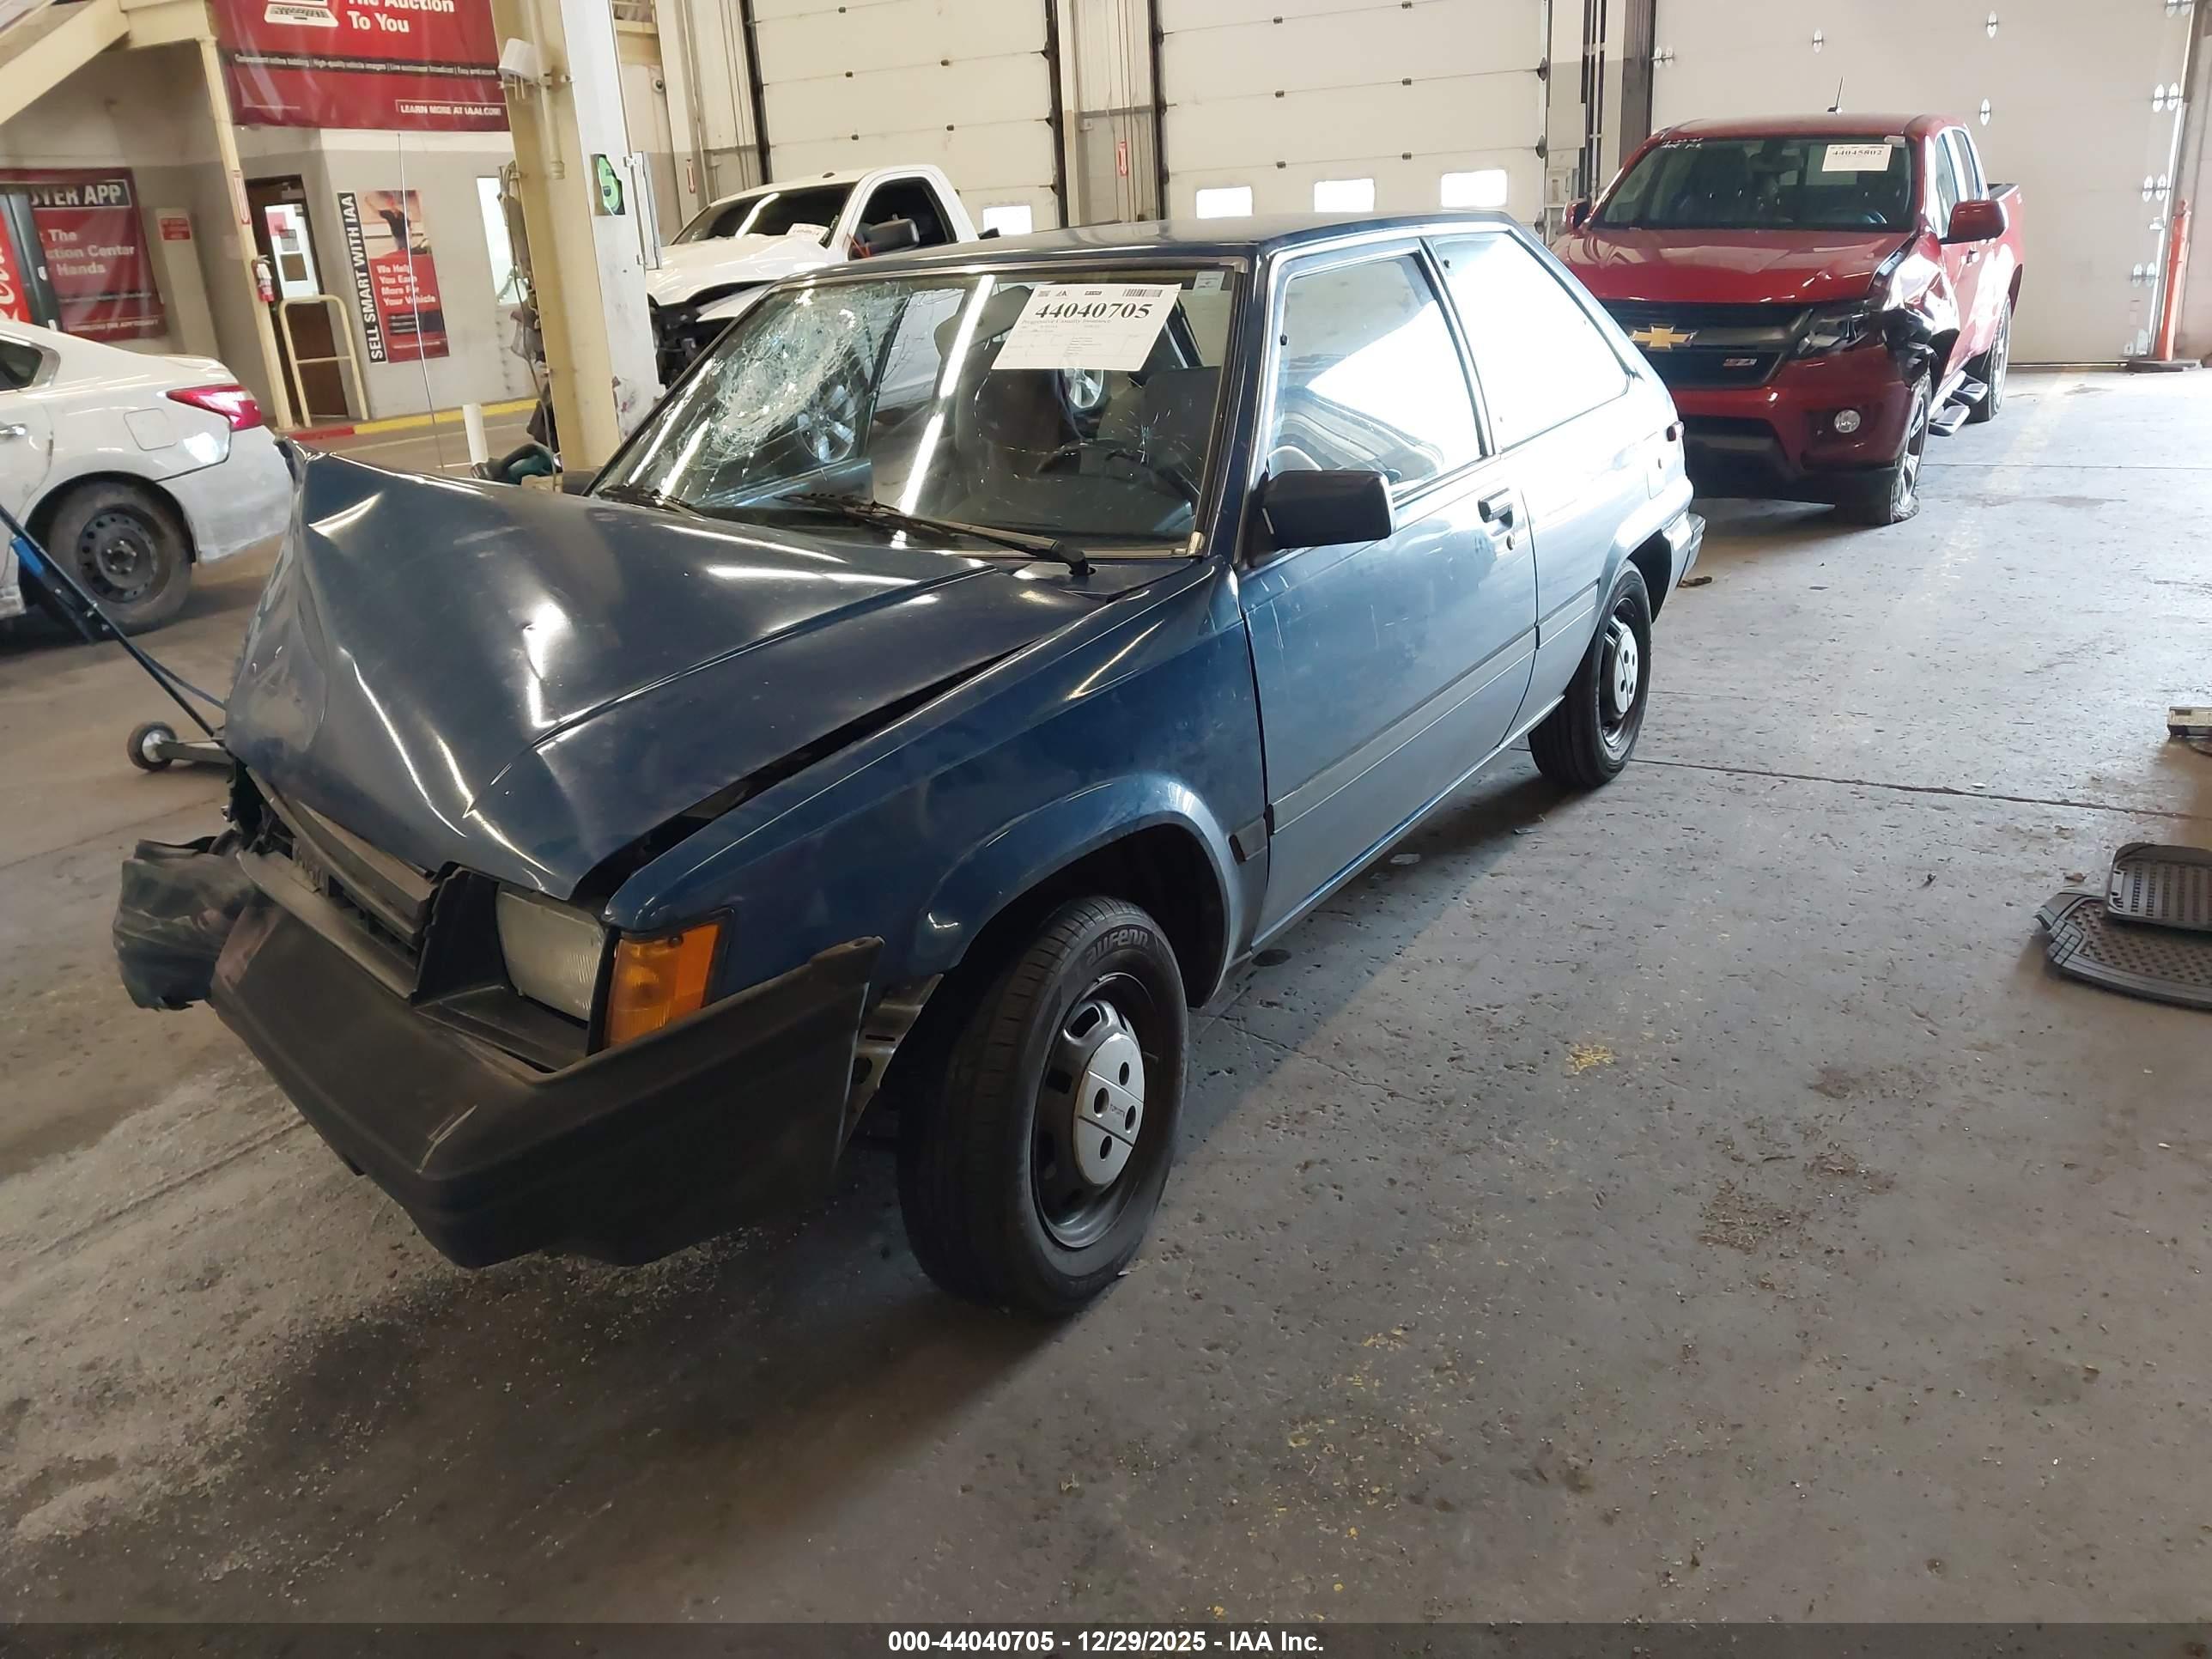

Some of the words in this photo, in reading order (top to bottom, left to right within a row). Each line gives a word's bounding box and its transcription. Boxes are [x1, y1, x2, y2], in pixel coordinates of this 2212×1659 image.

[346, 10, 371, 30] To
[374, 12, 410, 33] You
[400, 105, 428, 114] LEARN
[453, 106, 463, 115] AT
[84, 184, 121, 204] APP
[341, 197, 357, 222] IAA
[48, 229, 77, 241] The
[88, 245, 135, 257] Center
[348, 229, 365, 267] WITH
[56, 261, 106, 276] Hands
[356, 271, 376, 322] SMART
[1034, 302, 1153, 319] 44040705
[367, 327, 383, 359] SELL
